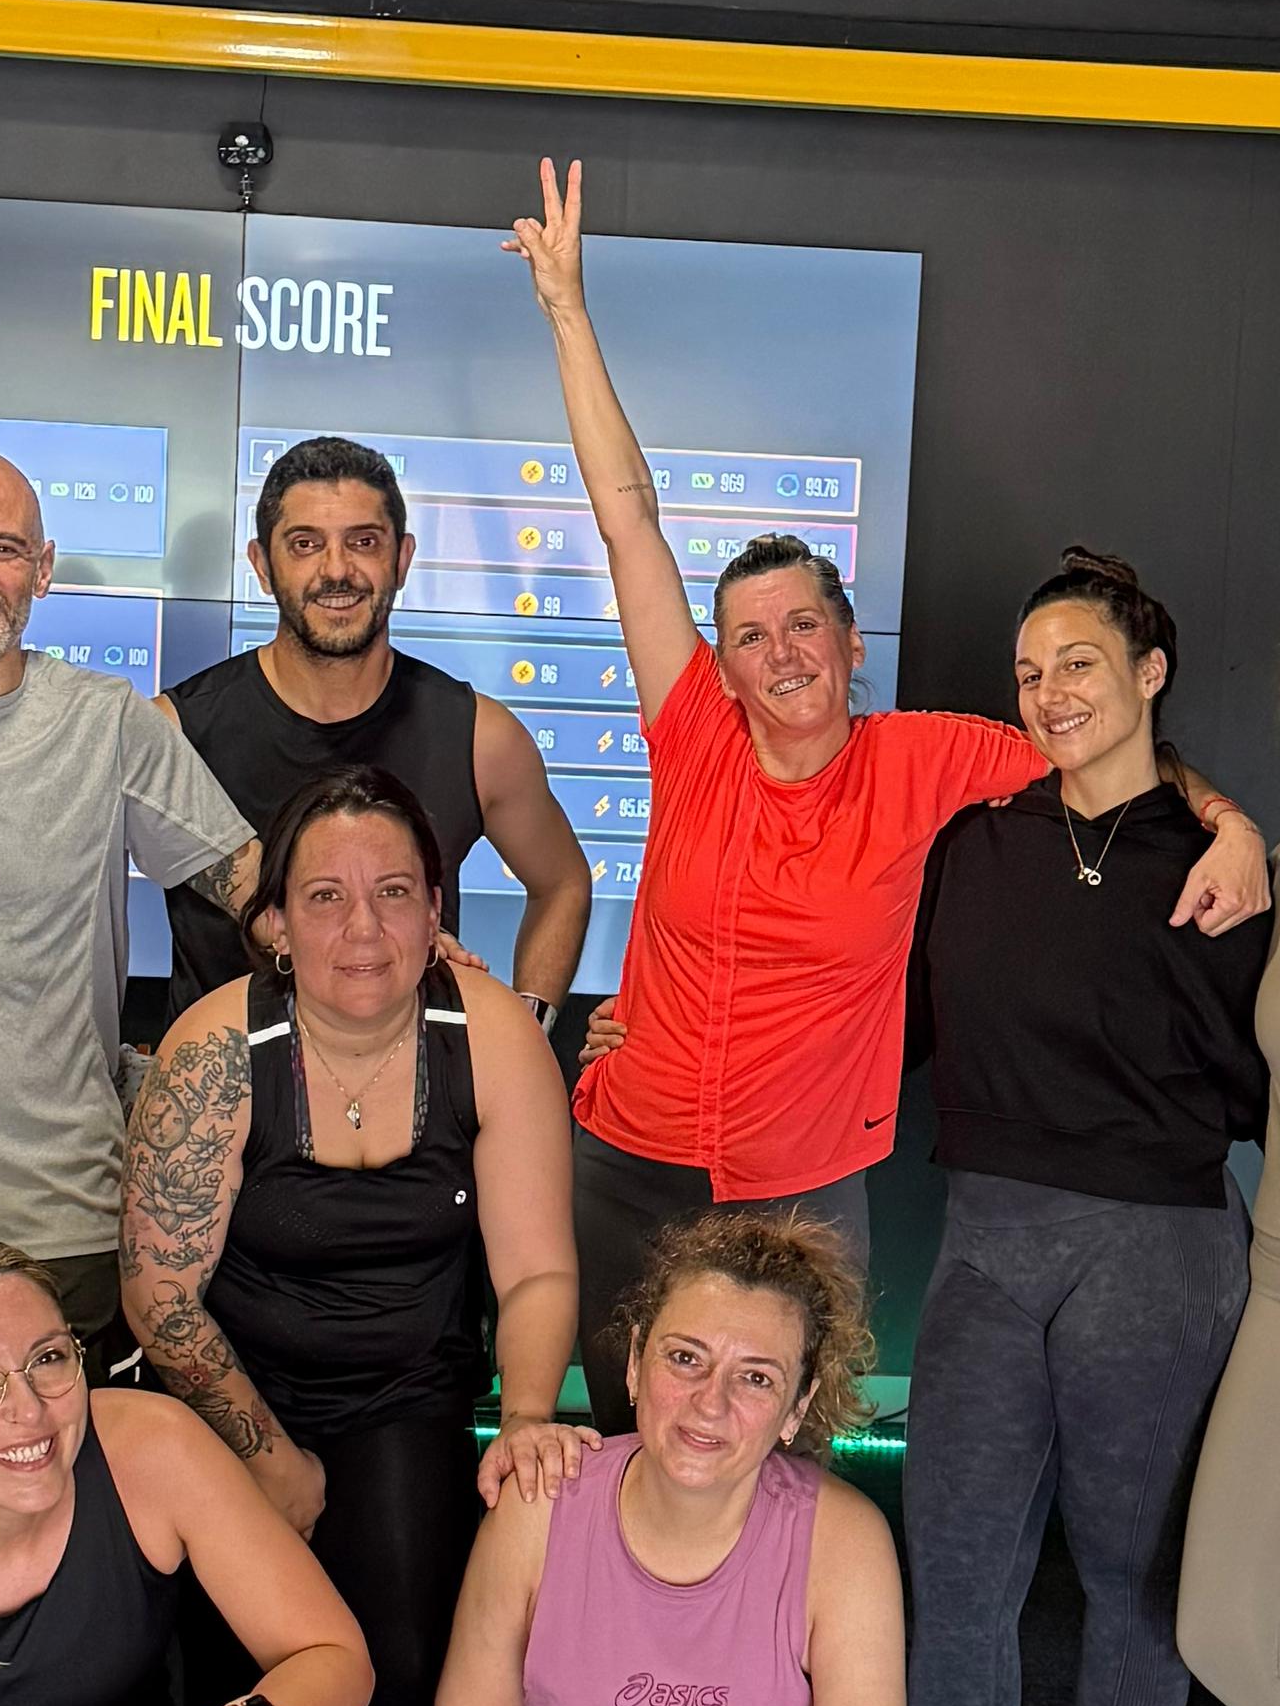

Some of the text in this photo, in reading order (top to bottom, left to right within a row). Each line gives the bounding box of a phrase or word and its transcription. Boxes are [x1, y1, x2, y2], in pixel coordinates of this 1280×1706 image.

[91, 267, 394, 357] FINAL SCORE
[134, 485, 154, 503] 100
[720, 473, 745, 493] 969
[805, 477, 839, 498] 99.76
[129, 648, 149, 666] 100
